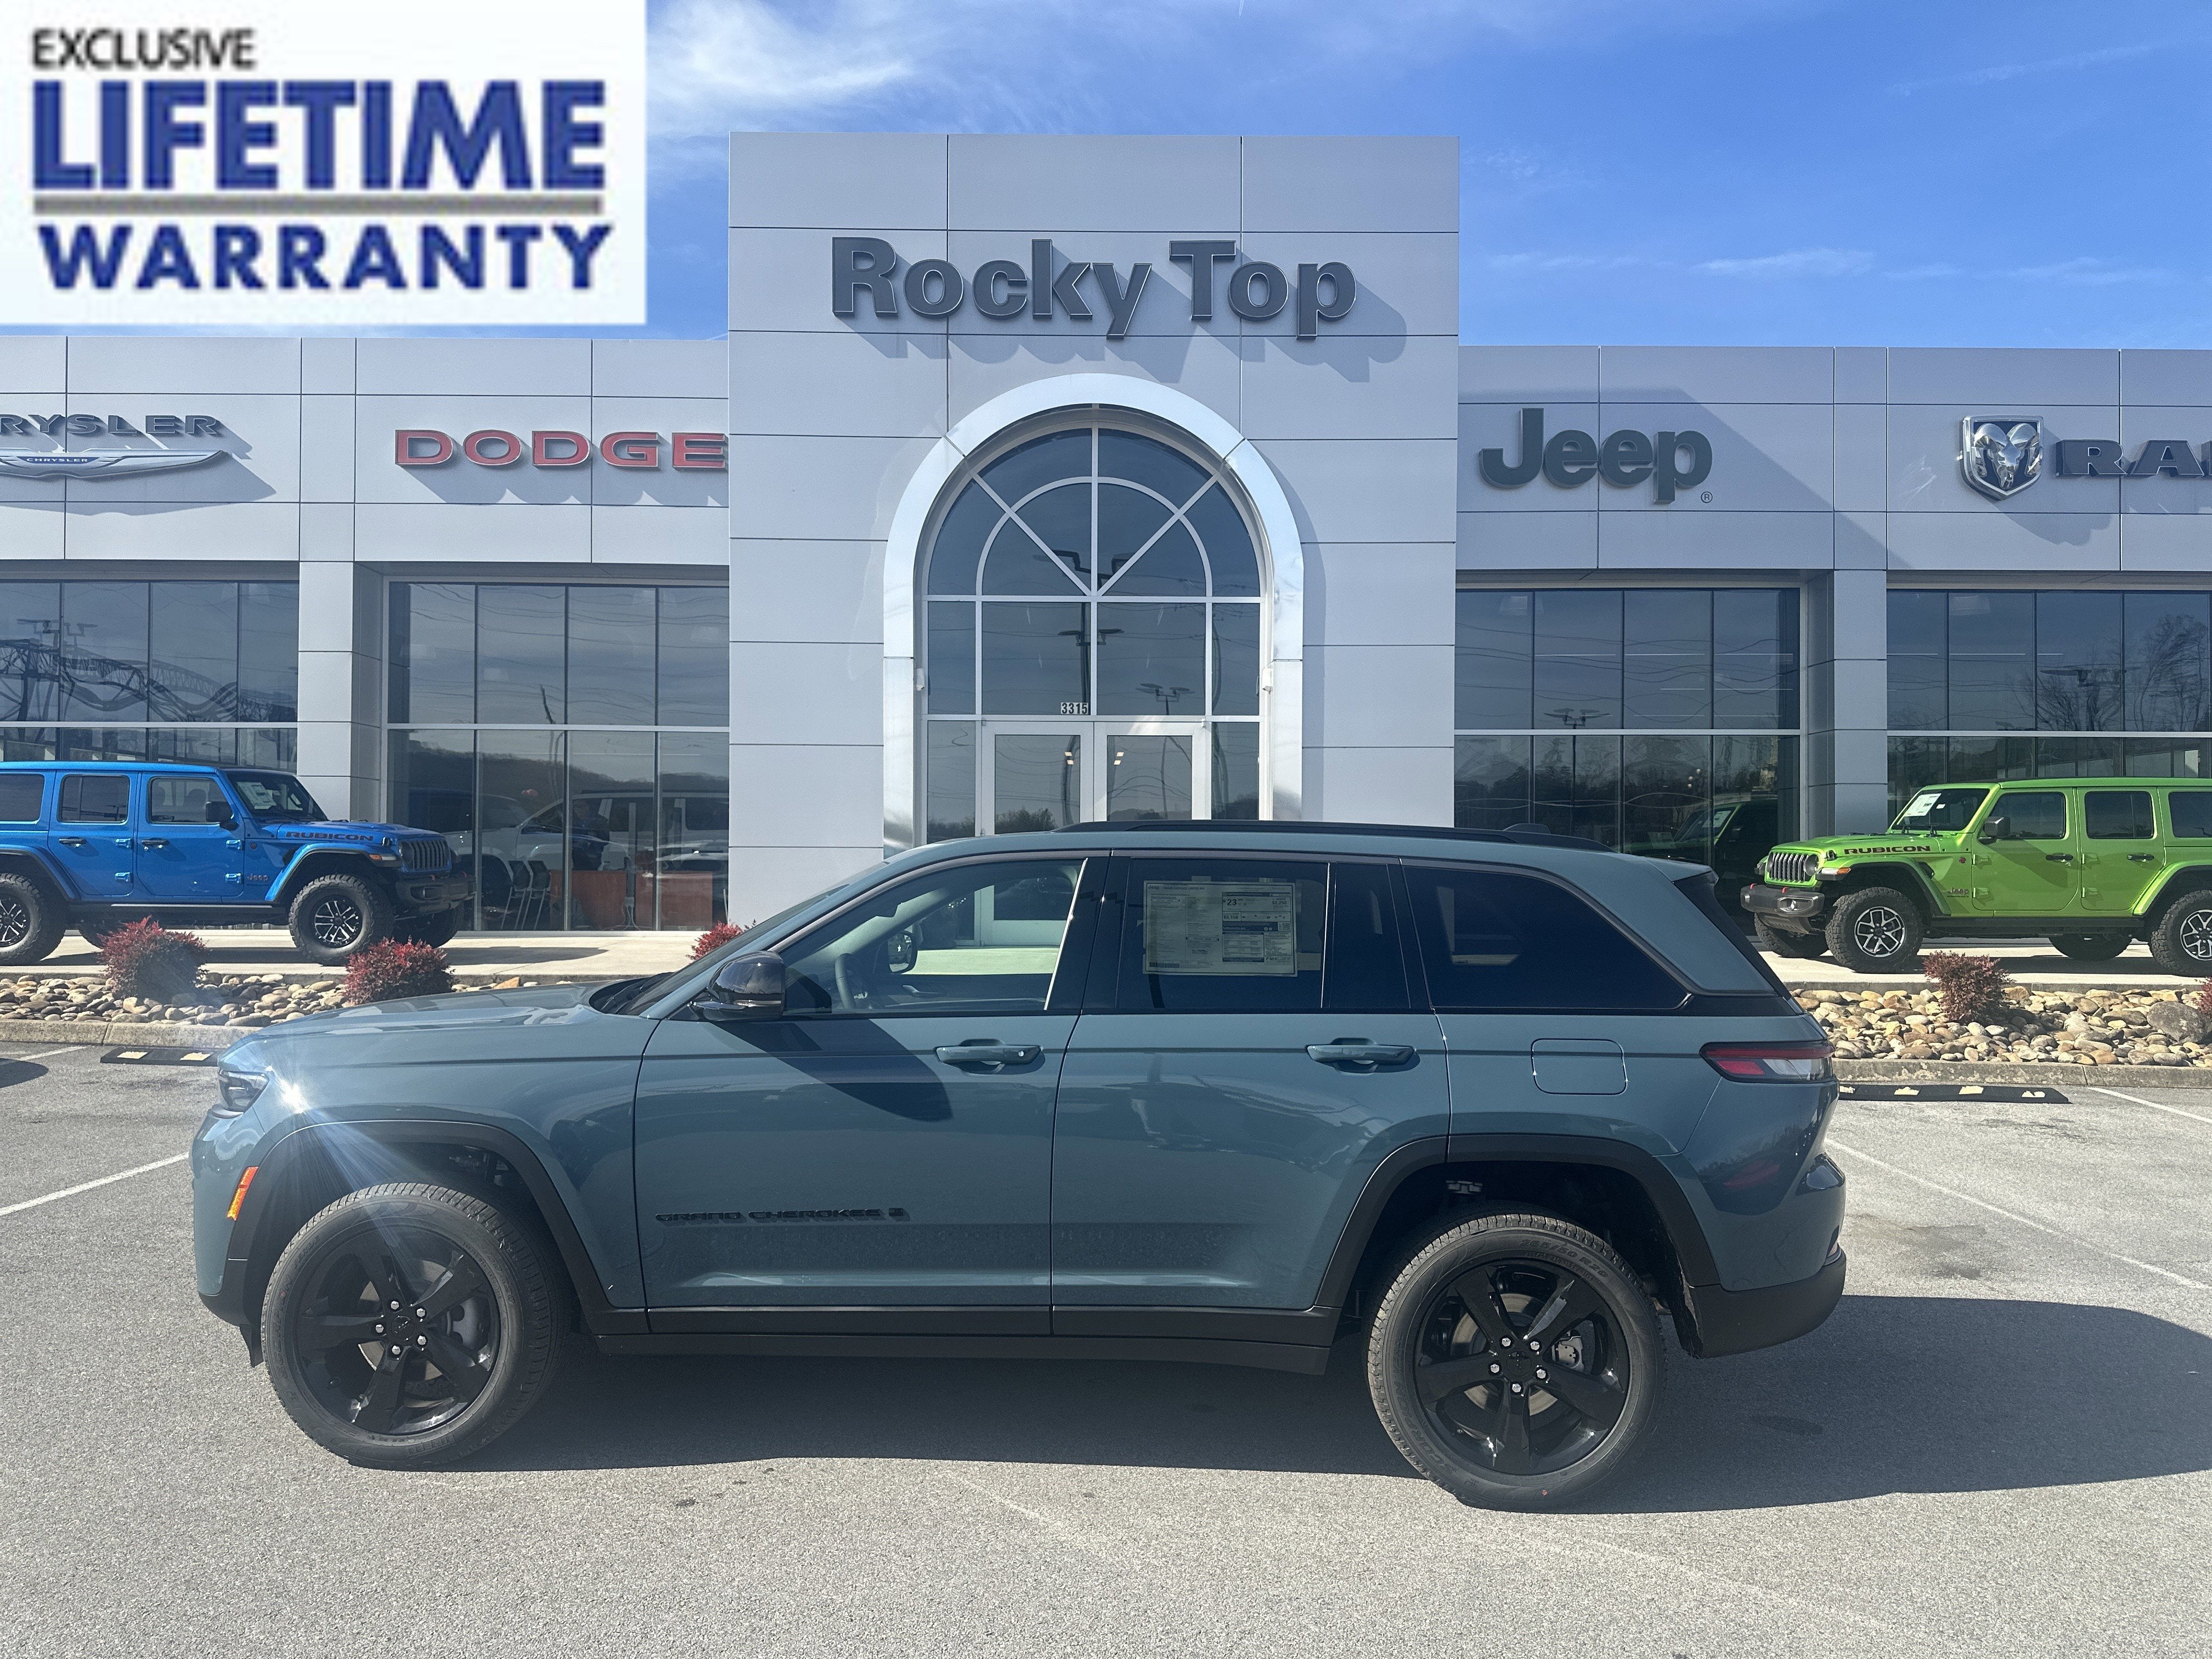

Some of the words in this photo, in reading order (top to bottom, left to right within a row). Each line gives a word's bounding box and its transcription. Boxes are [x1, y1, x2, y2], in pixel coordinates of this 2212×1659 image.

[832, 236, 1153, 340] Rocky
[1169, 240, 1357, 340] Top
[395, 429, 728, 470] DODGE
[1479, 407, 1713, 505] Jeep
[2056, 439, 2212, 477] RA
[1062, 703, 1087, 714] 3315
[286, 831, 374, 842] RUBICON
[1843, 845, 1931, 855] RUBICON
[1947, 886, 1969, 895] Jeep
[655, 1211, 741, 1222] GRAND
[748, 1207, 881, 1219] CHEROKEE
